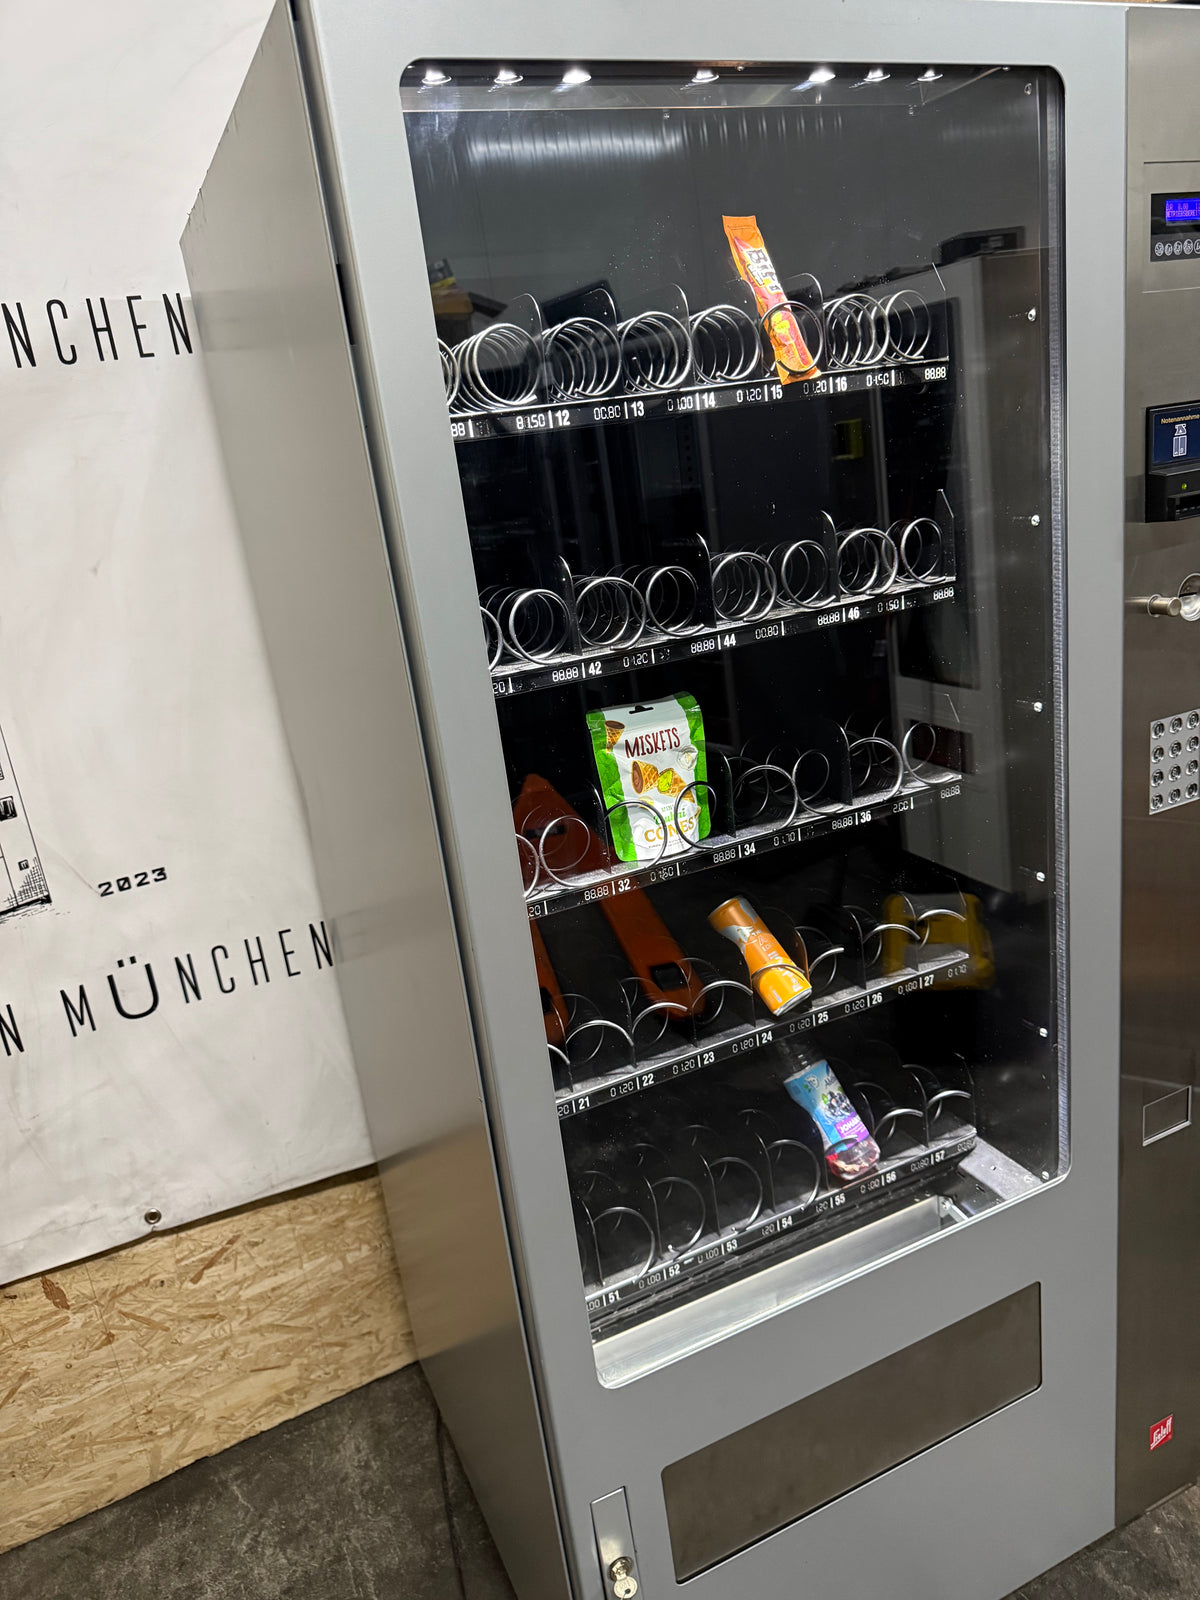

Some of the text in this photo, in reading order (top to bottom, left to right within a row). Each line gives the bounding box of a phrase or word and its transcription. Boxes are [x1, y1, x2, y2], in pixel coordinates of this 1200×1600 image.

[0, 293, 194, 368] NCHEN
[555, 410, 570, 426] 12
[630, 400, 645, 417] 13
[702, 392, 716, 408] 14
[771, 384, 783, 400] 15
[835, 376, 848, 391] 16
[1161, 414, 1199, 424] Notenannahme
[552, 667, 579, 682] 88.88
[589, 661, 602, 676] 42
[690, 639, 715, 653] 88.88
[723, 633, 736, 647] 44
[848, 606, 860, 620] 46
[624, 727, 680, 759] MISKETS
[584, 885, 609, 901] 88.88
[618, 879, 631, 892] 32
[744, 842, 756, 856] 34
[860, 811, 872, 823] 36
[644, 816, 694, 843] CONES
[98, 867, 167, 897] 2023
[60, 921, 334, 1037] MÜNCHEN
[578, 1096, 590, 1110] 21
[642, 1073, 655, 1087] 22
[703, 1051, 715, 1065] 23
[761, 1031, 773, 1044] 24
[817, 1011, 829, 1024] 25
[871, 993, 883, 1005] 26
[924, 974, 935, 987] 27
[608, 1291, 620, 1303] 51
[668, 1264, 680, 1277] 52
[726, 1239, 738, 1252] 53
[781, 1215, 793, 1229] 54
[834, 1192, 846, 1206] 55
[886, 1171, 896, 1183] 56
[935, 1150, 945, 1162] 57
